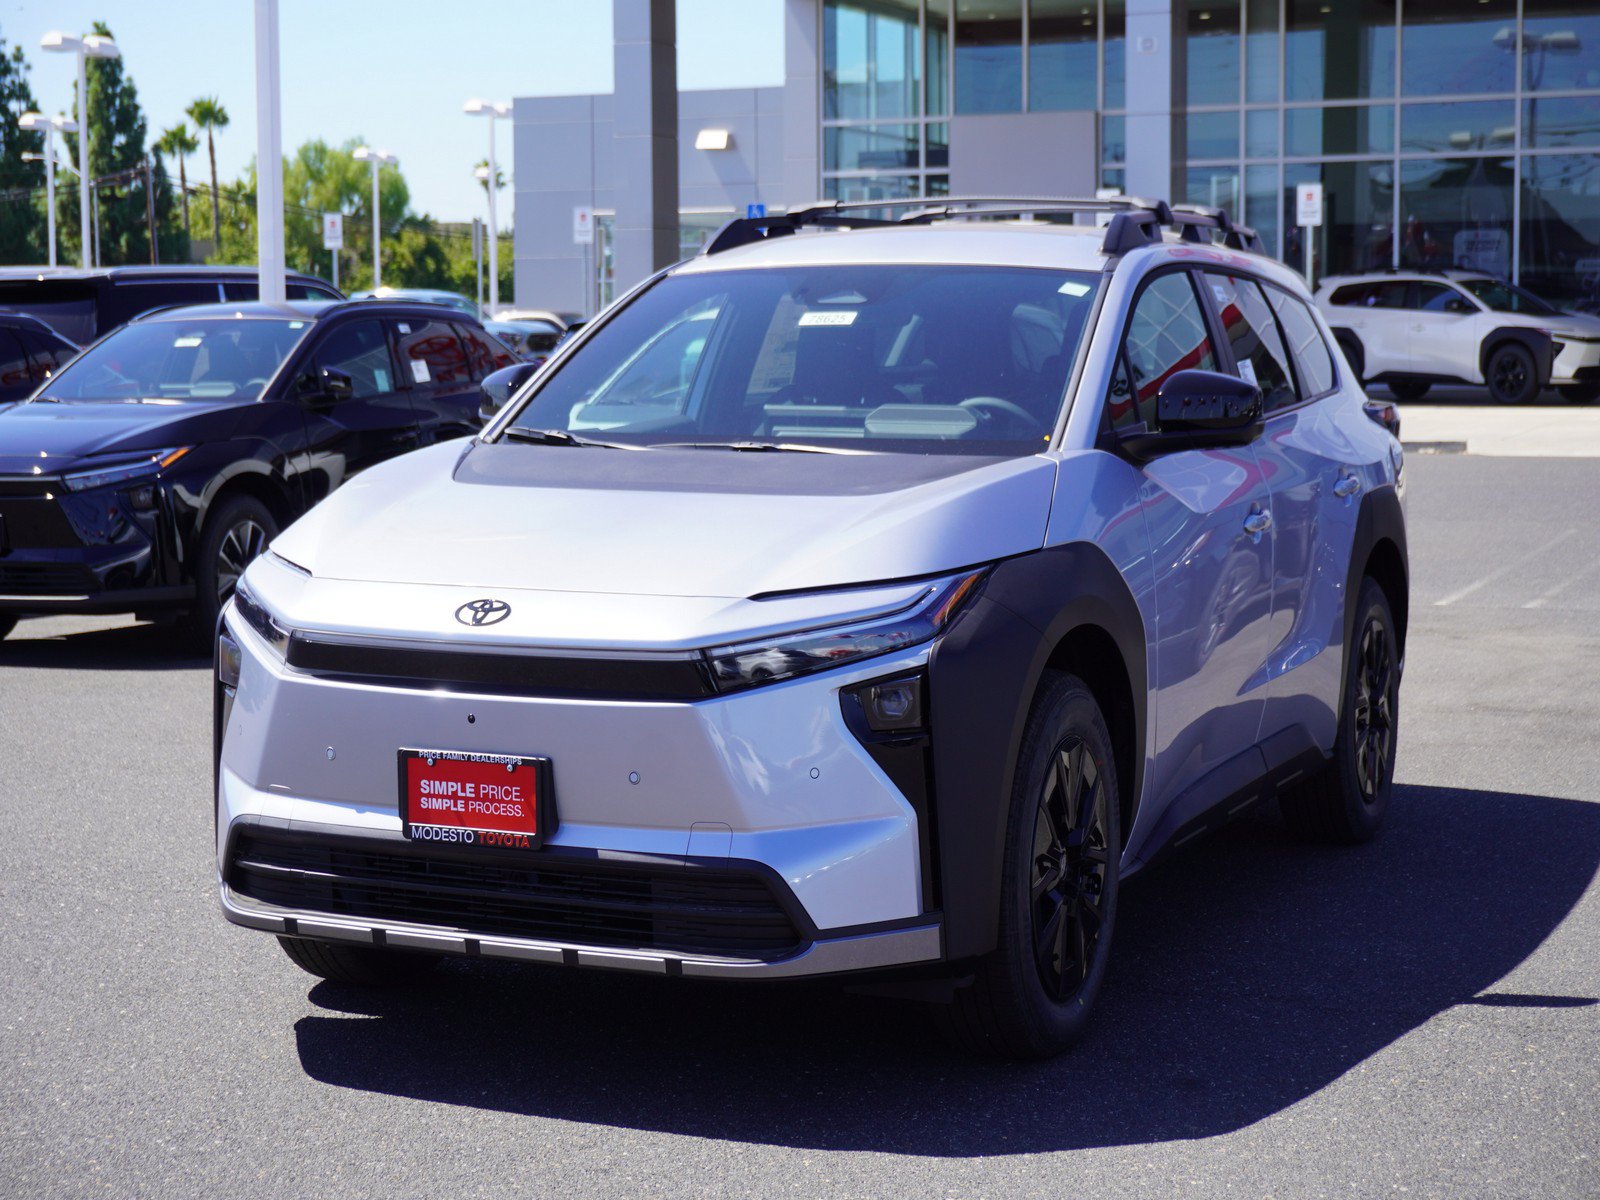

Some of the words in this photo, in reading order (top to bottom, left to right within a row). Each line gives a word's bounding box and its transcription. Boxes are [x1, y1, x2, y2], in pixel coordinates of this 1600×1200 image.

[418, 751, 442, 759] PRICE
[443, 752, 468, 761] FAMILY
[470, 754, 522, 765] DEALERSHIPS
[420, 779, 475, 797] SIMPLE
[479, 784, 524, 802] PRICE.
[420, 797, 465, 812] SIMPLE
[468, 801, 525, 817] PROCESS.
[411, 825, 474, 843] MODESTO
[478, 831, 530, 848] TOYOTA
